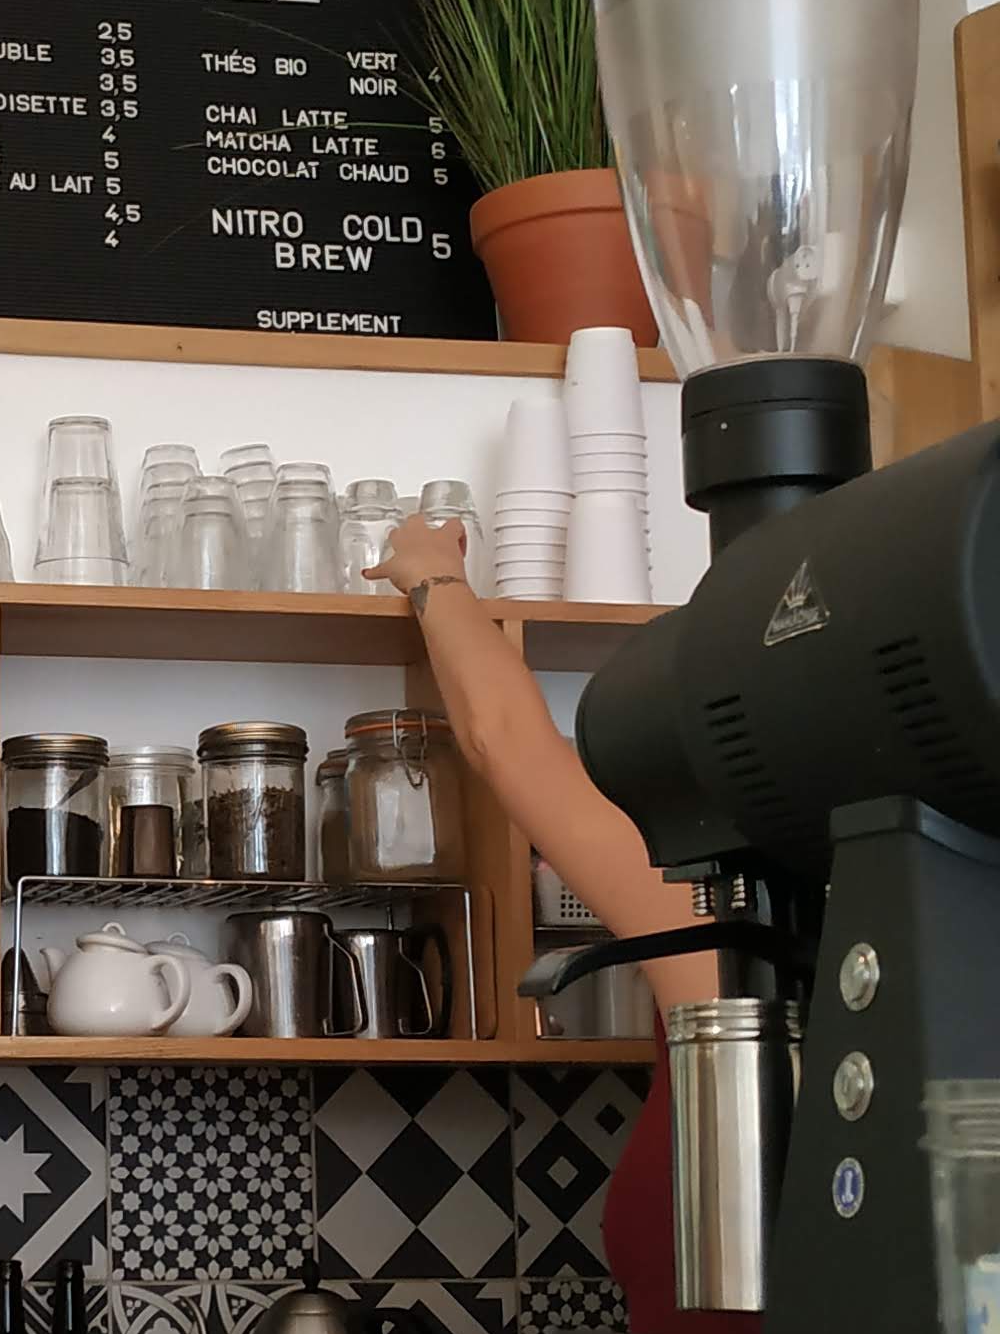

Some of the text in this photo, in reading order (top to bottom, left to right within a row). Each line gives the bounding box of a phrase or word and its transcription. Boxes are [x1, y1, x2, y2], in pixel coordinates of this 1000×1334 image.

[98, 22, 132, 43] 2,5
[100, 48, 135, 69] 3,5
[201, 48, 398, 76] THÉS BIO VERT
[99, 72, 137, 95] 3,5
[428, 67, 441, 83] 4
[350, 77, 398, 96] NOIR
[100, 98, 138, 121] 3,5
[205, 105, 348, 130] CHAI LATTE
[102, 125, 116, 144] 4
[428, 116, 443, 134] 5
[205, 131, 379, 156] MATCHA LATTE
[431, 142, 446, 160] 6
[104, 151, 119, 169] 5
[207, 156, 409, 184] CHOCOLAT CHAUD
[9, 172, 36, 191] AU
[51, 174, 94, 194] LAIT
[106, 177, 121, 195] 5
[433, 168, 448, 186] 5
[105, 204, 141, 225] 4,5
[212, 208, 423, 243] NITRO COLD
[105, 230, 119, 248] 4
[432, 234, 452, 260] 5
[275, 242, 372, 272] BREW
[257, 309, 401, 333] SUPPLEMENT
